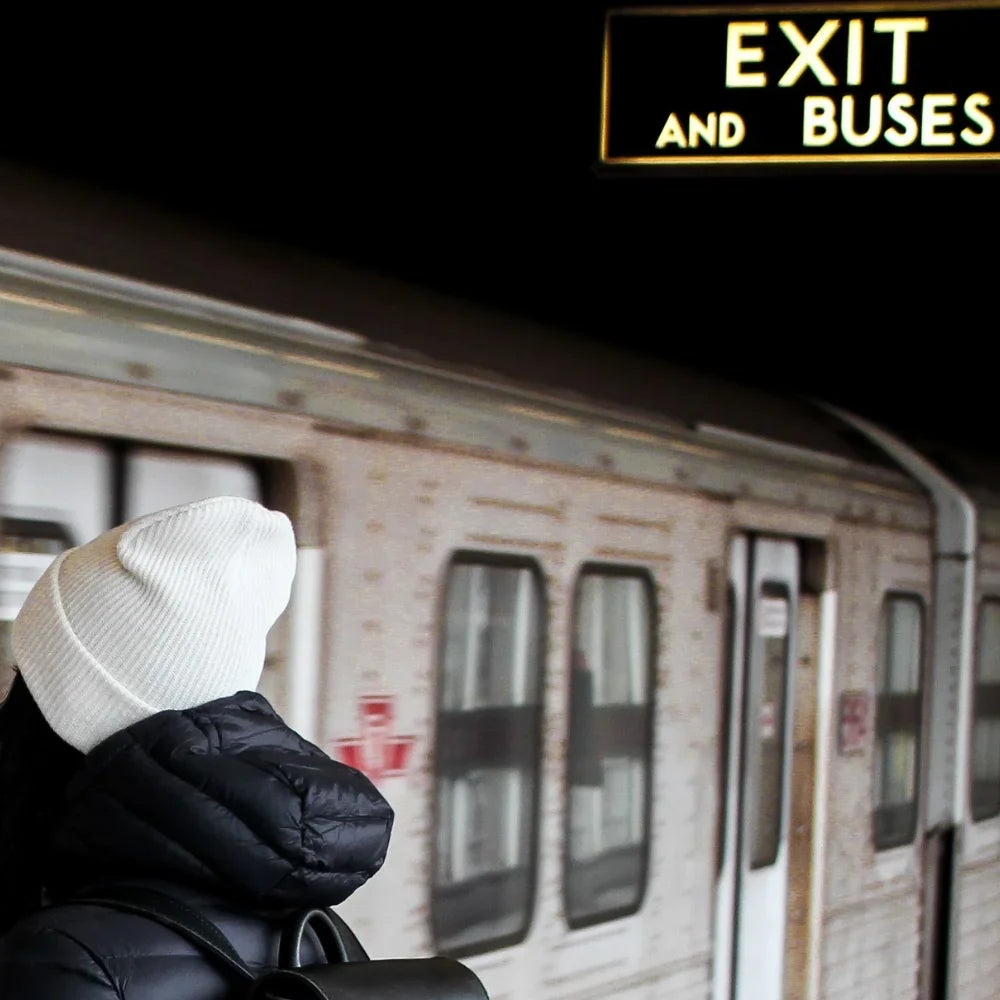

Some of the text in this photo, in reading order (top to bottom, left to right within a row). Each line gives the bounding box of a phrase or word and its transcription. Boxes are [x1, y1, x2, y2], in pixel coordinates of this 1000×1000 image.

[725, 17, 929, 88] EXIT
[655, 92, 995, 149] AND BUSES
